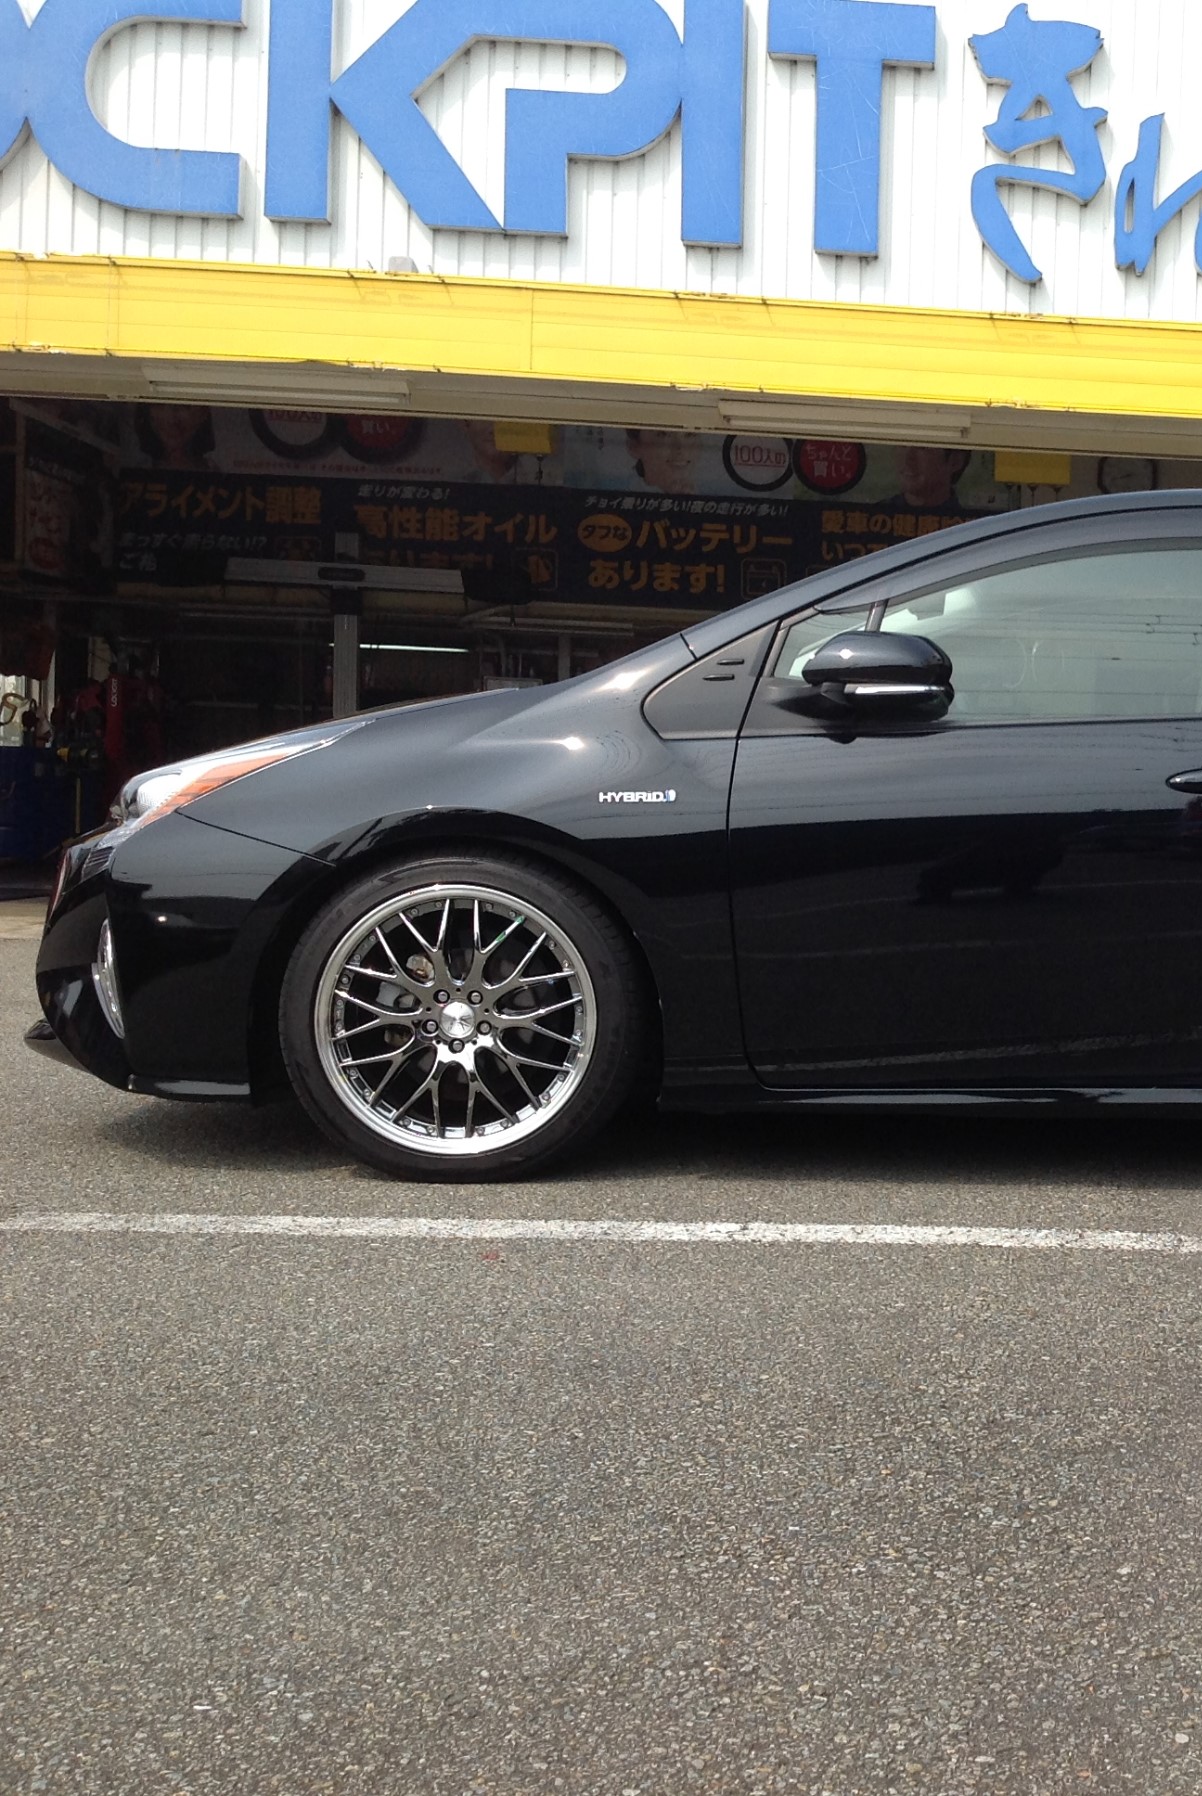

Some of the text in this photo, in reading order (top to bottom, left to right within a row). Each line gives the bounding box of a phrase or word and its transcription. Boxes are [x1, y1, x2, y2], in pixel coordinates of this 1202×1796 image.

[0, 0, 935, 258] CKPIT
[735, 445, 786, 465] 100人の
[353, 504, 560, 544] 高性能オイル
[635, 518, 795, 555] バッテリー
[587, 559, 727, 594] あります!
